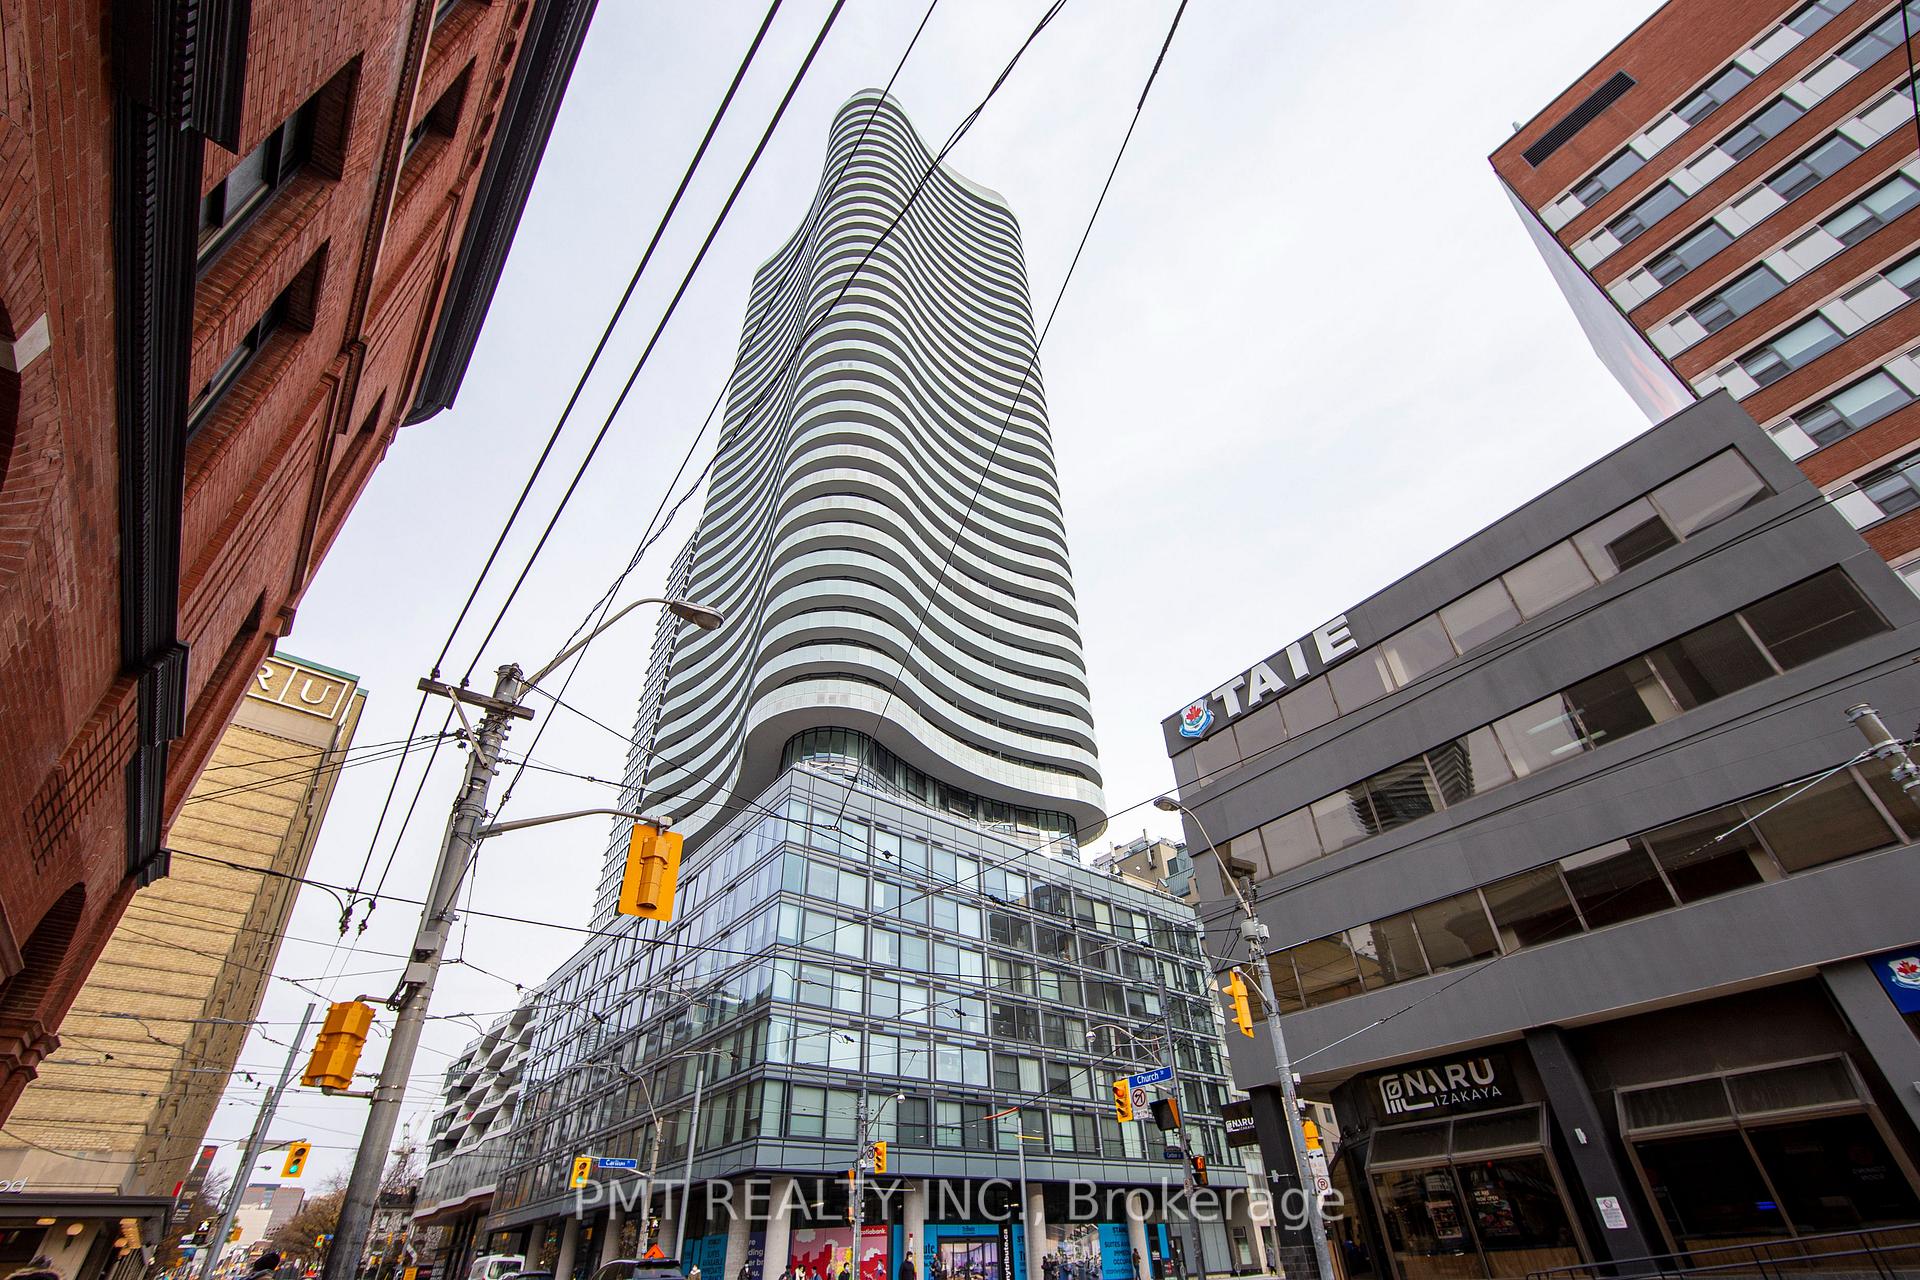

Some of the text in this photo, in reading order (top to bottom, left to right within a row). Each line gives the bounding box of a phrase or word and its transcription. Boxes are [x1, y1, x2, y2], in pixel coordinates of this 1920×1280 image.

[1211, 614, 1359, 719] TAIE
[1136, 1073, 1160, 1084] Church
[1434, 1085, 1502, 1106] IZAKAYA
